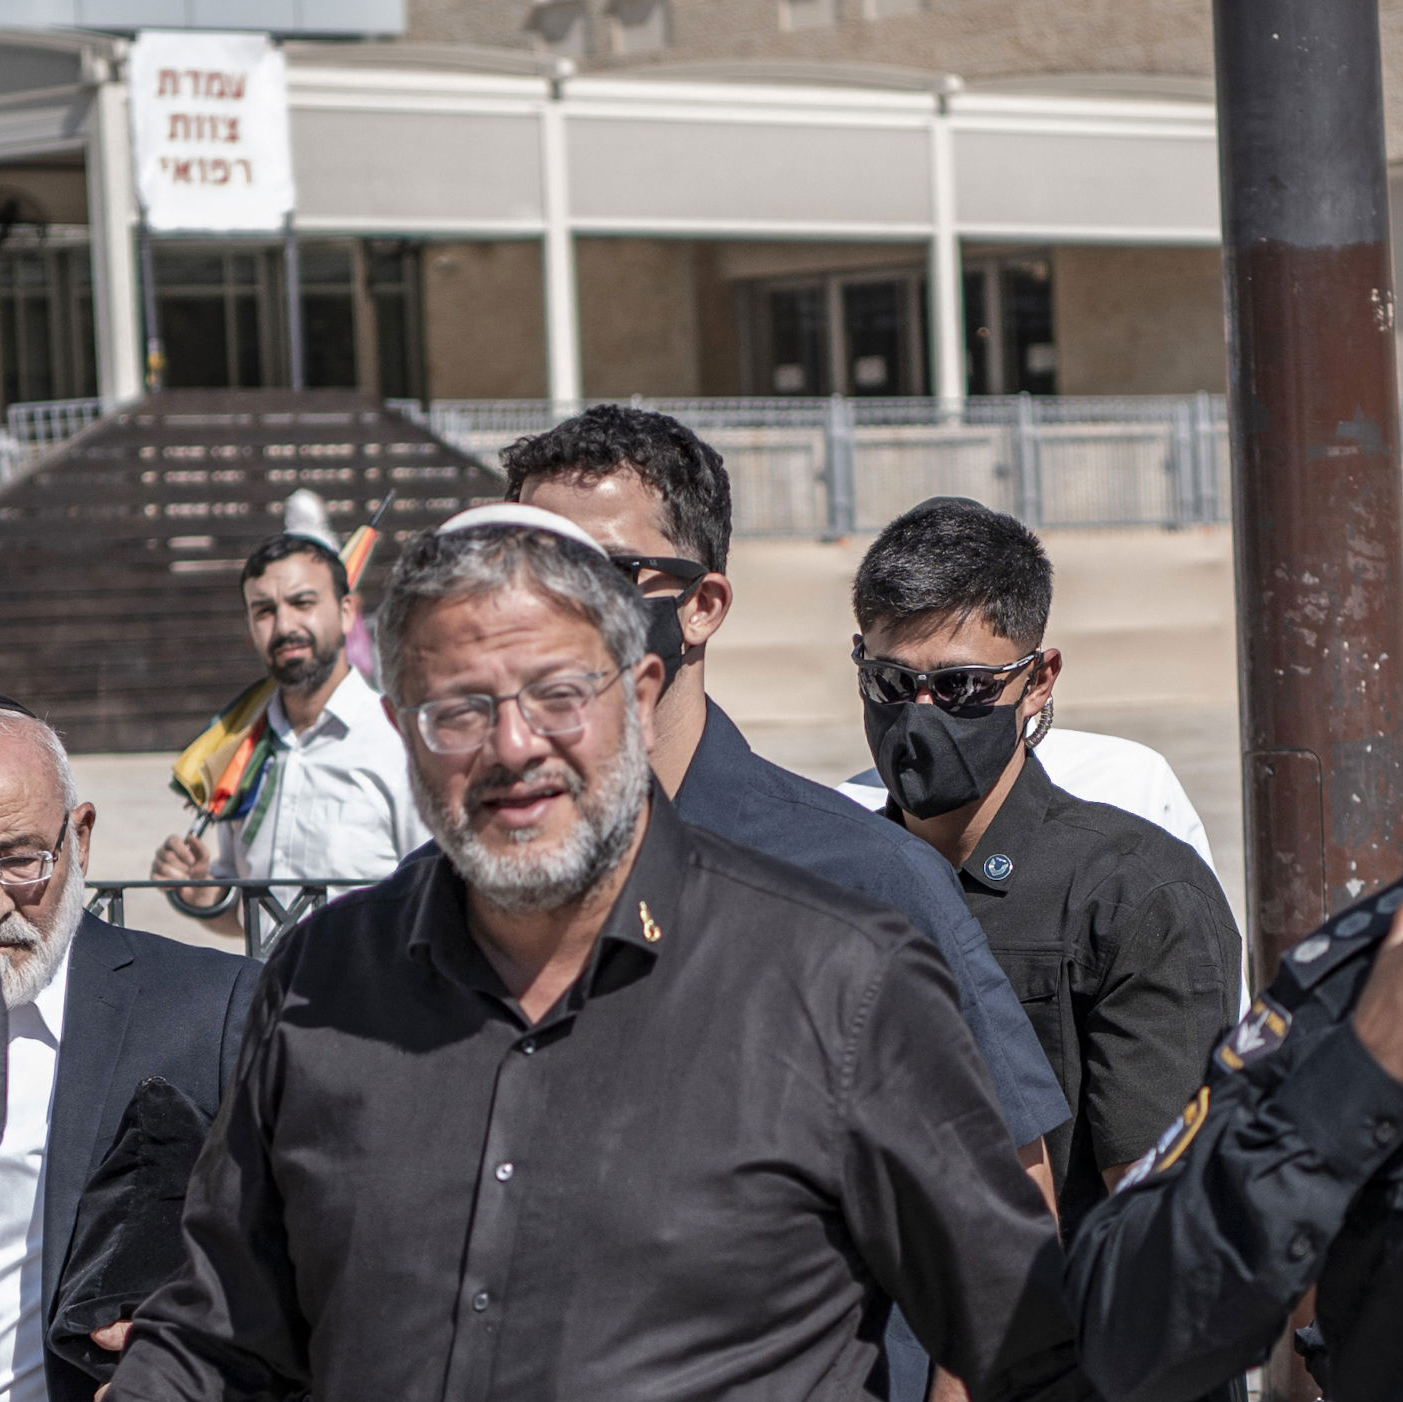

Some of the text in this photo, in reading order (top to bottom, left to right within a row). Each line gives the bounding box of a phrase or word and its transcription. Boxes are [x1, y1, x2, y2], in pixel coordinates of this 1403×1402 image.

[157, 69, 247, 100] עמדת
[168, 113, 240, 142] צוות
[159, 157, 253, 185] רפואי
